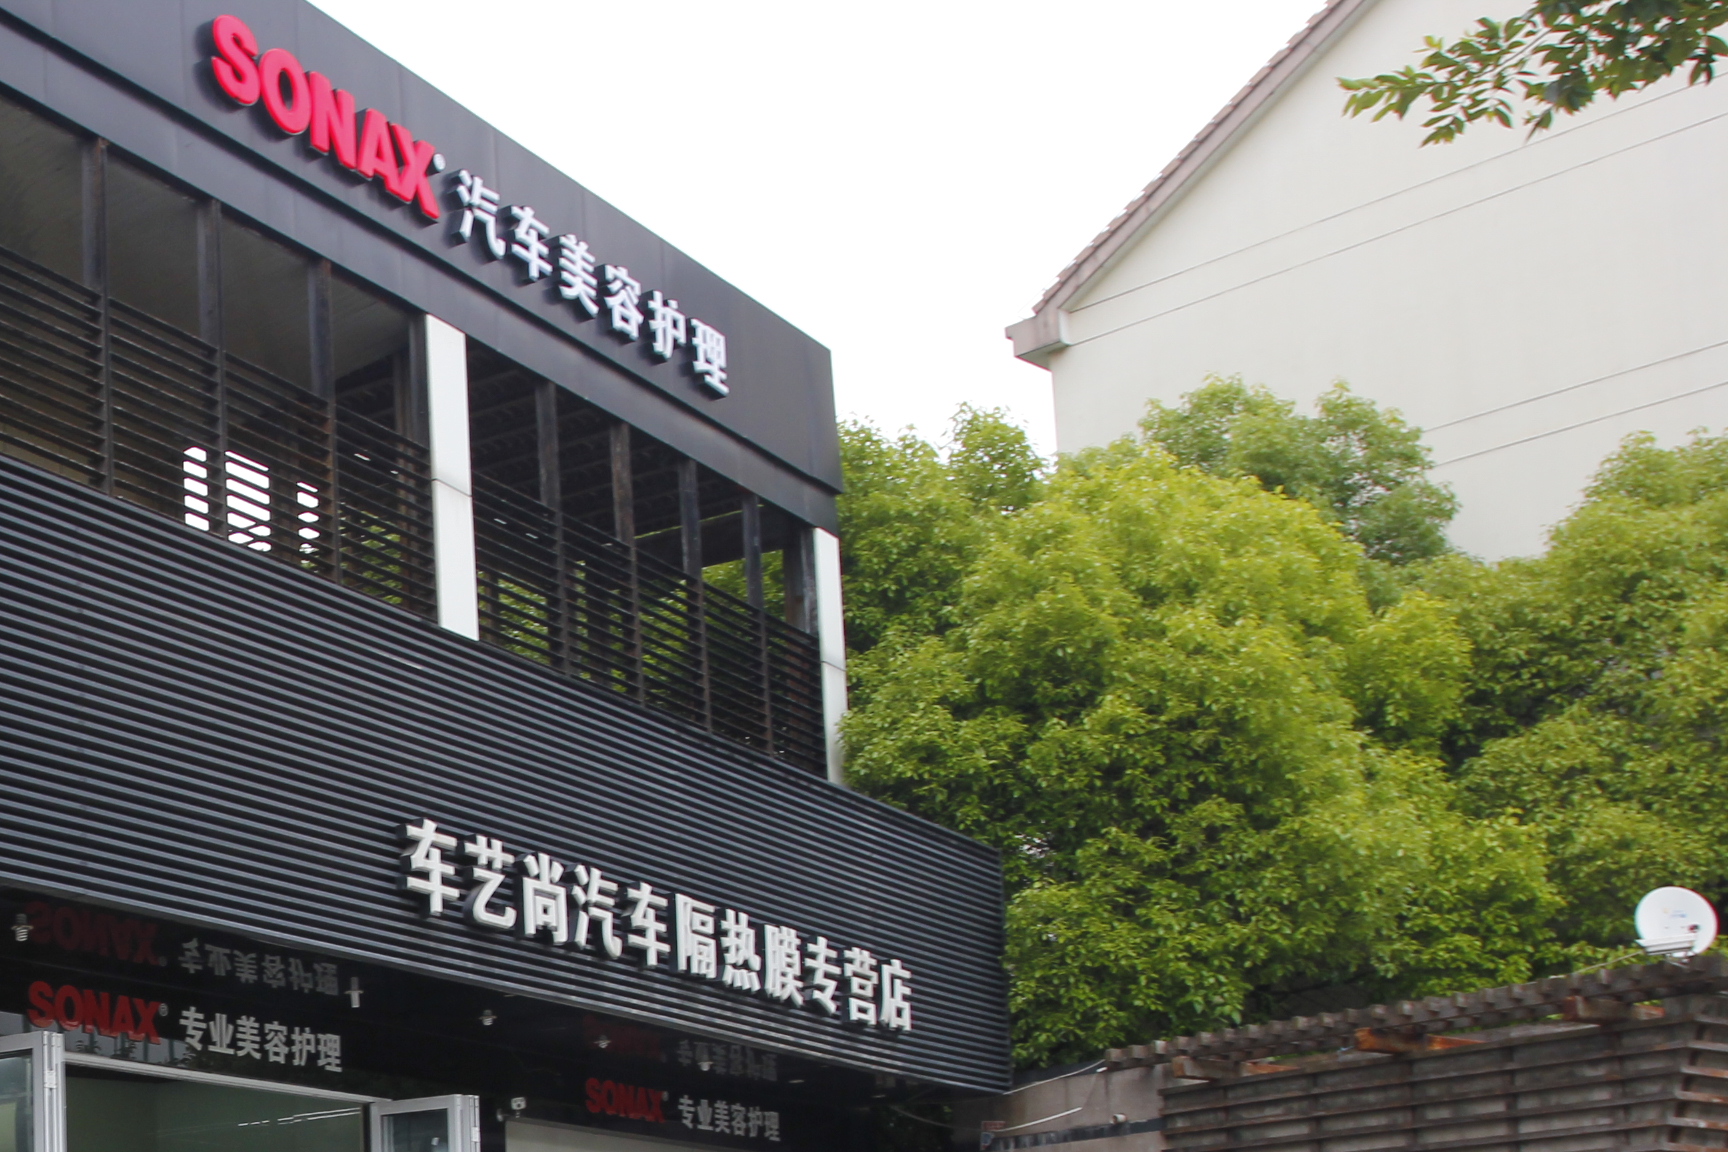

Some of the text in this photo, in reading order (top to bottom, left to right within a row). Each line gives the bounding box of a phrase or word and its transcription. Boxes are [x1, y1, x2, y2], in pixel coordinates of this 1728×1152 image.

[209, 14, 441, 221] SONAX
[453, 169, 730, 398] 汽车美容护理
[404, 817, 913, 1033] 车艺尚汽车隔热膜专营店
[27, 981, 162, 1045] SONAX
[179, 1006, 343, 1073] 专业美容护理
[585, 1077, 666, 1124] SONAX
[678, 1095, 781, 1142] 专业美容护理
